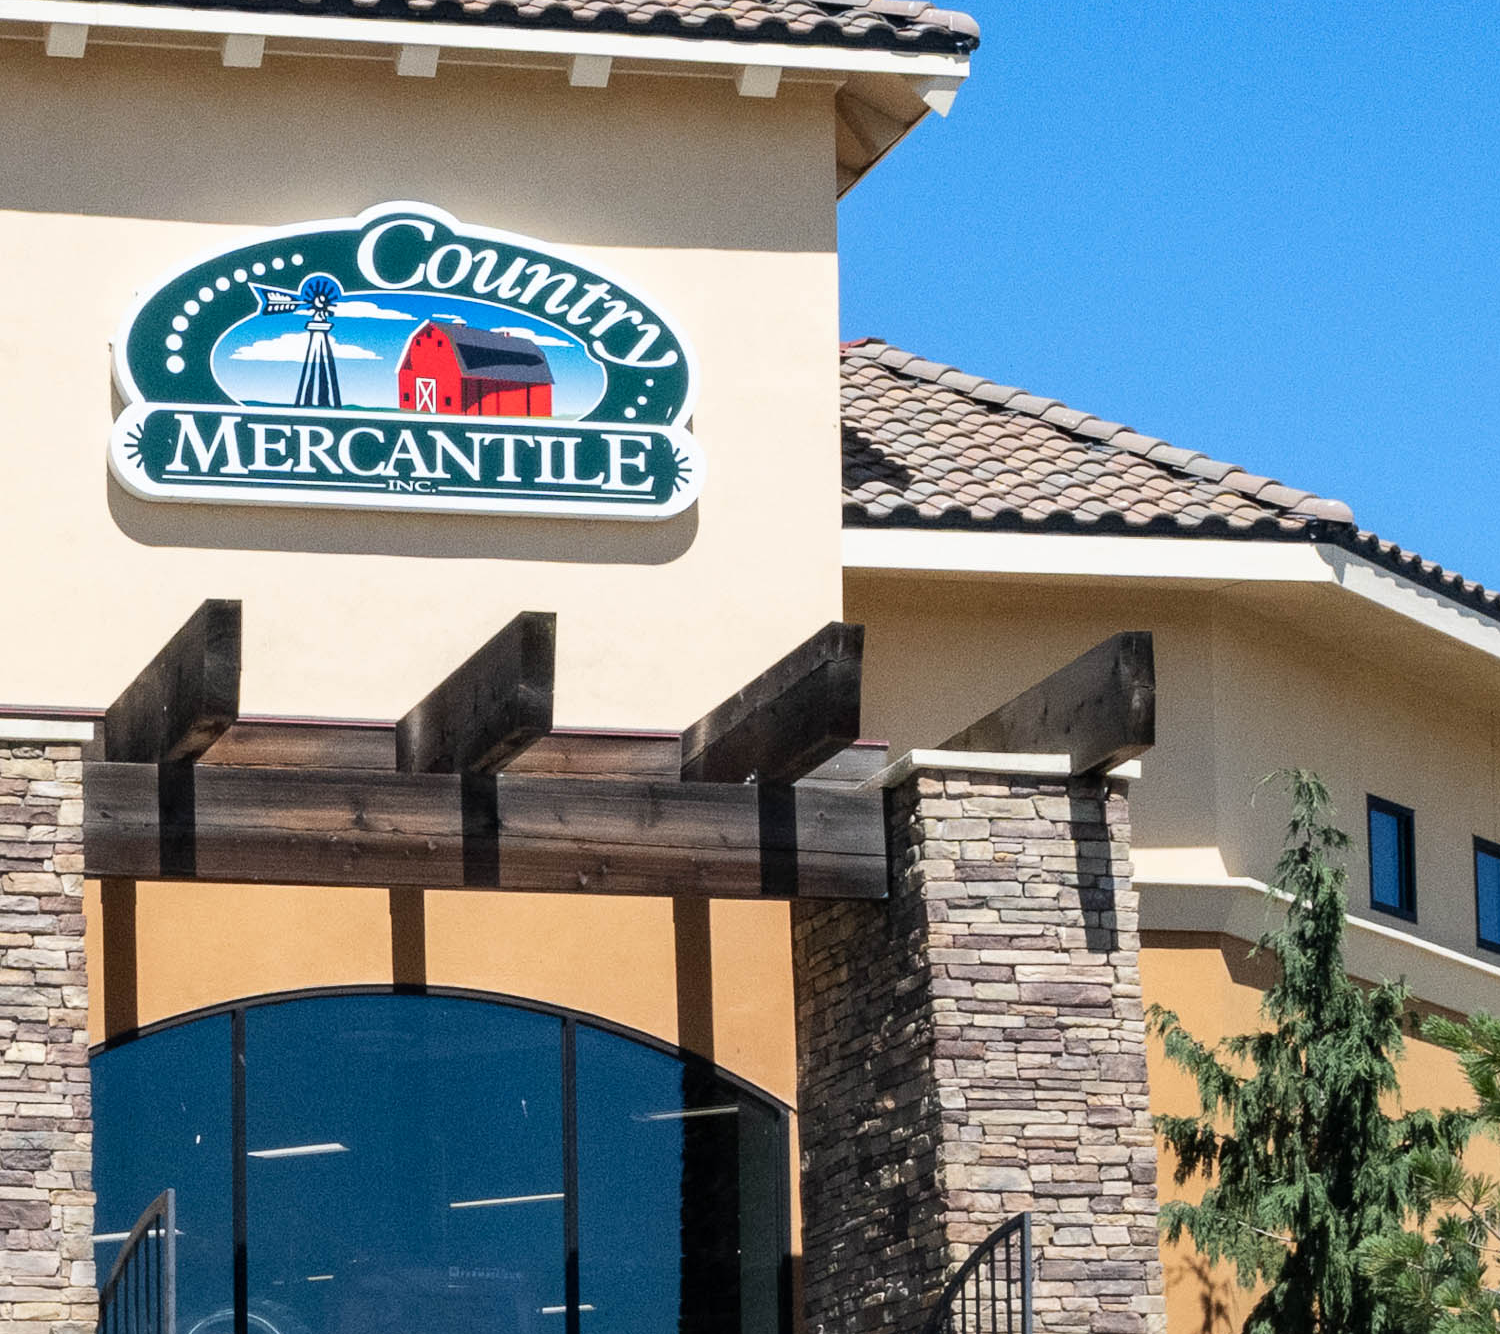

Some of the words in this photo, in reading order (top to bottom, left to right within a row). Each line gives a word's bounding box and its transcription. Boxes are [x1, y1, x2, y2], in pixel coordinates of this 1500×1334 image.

[356, 218, 679, 369] Country
[167, 414, 654, 492] MERCANTILE
[388, 479, 437, 493] INC.
